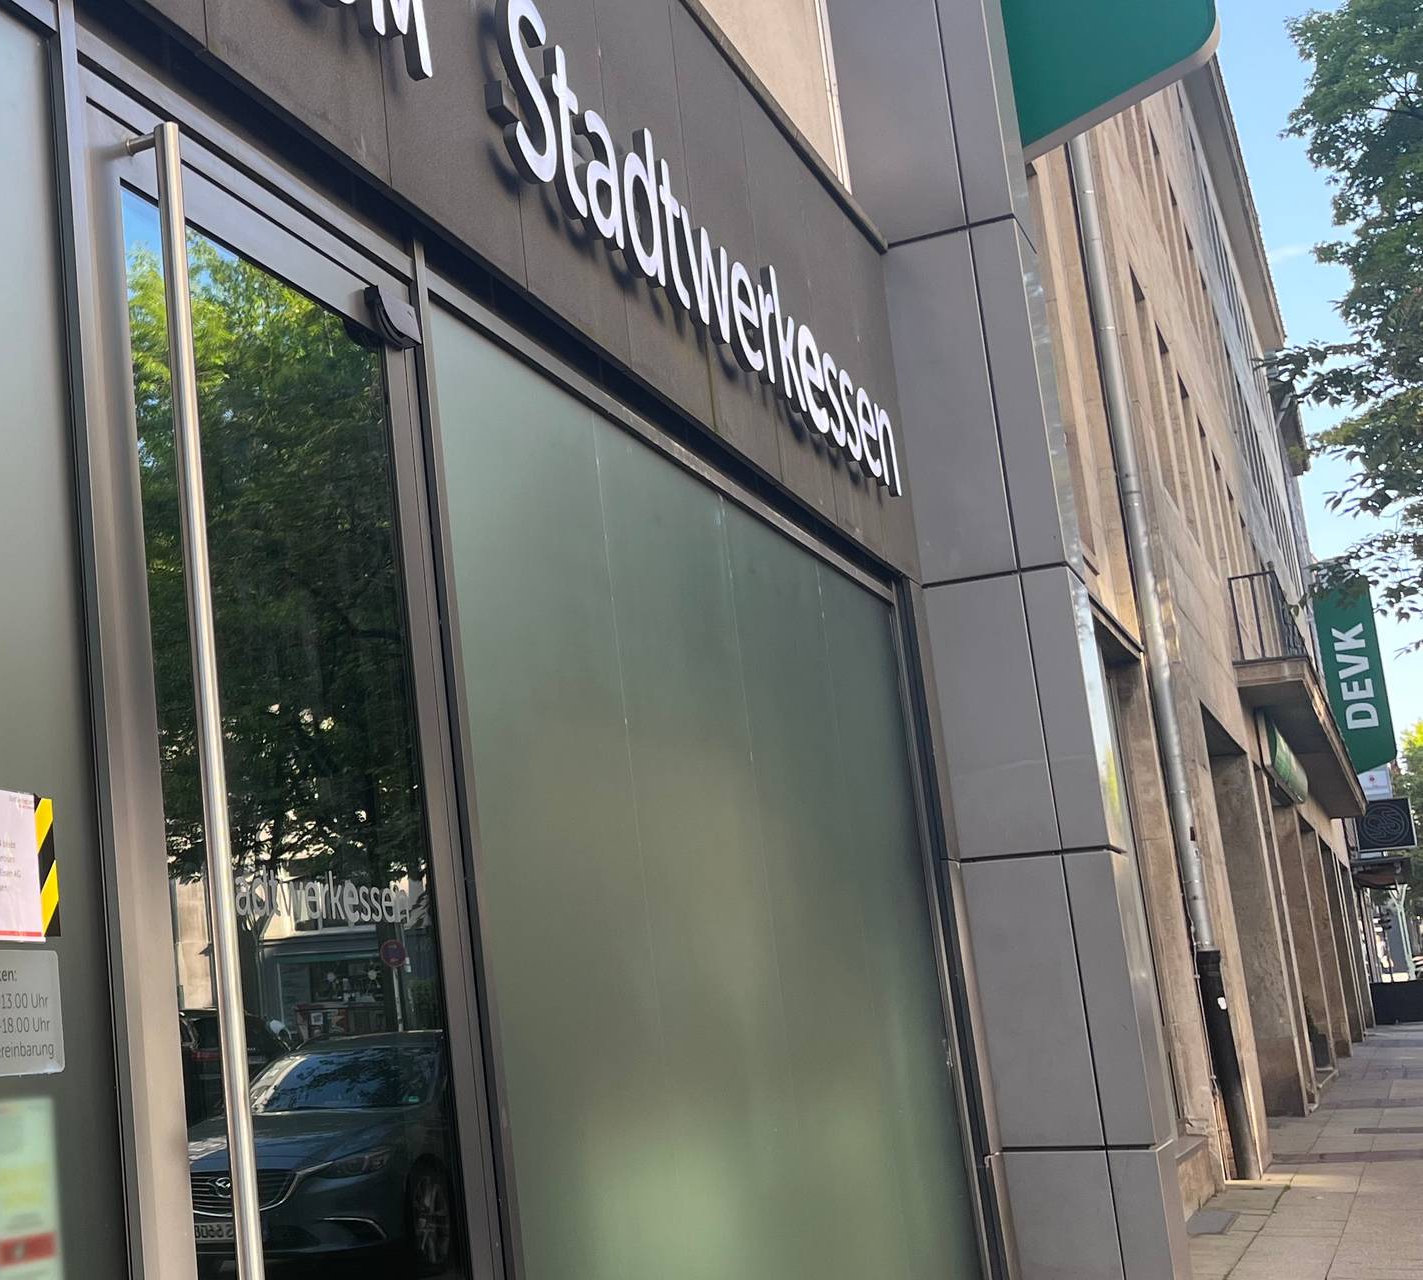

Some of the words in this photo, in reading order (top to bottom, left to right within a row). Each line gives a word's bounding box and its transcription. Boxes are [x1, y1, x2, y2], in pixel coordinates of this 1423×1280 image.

[507, 0, 901, 497] Stadtwerkessen
[1331, 623, 1379, 730] DEVK
[235, 864, 409, 923] adtwerkessen
[31, 993, 49, 1009] Uhr
[32, 1016, 50, 1033] Uhr
